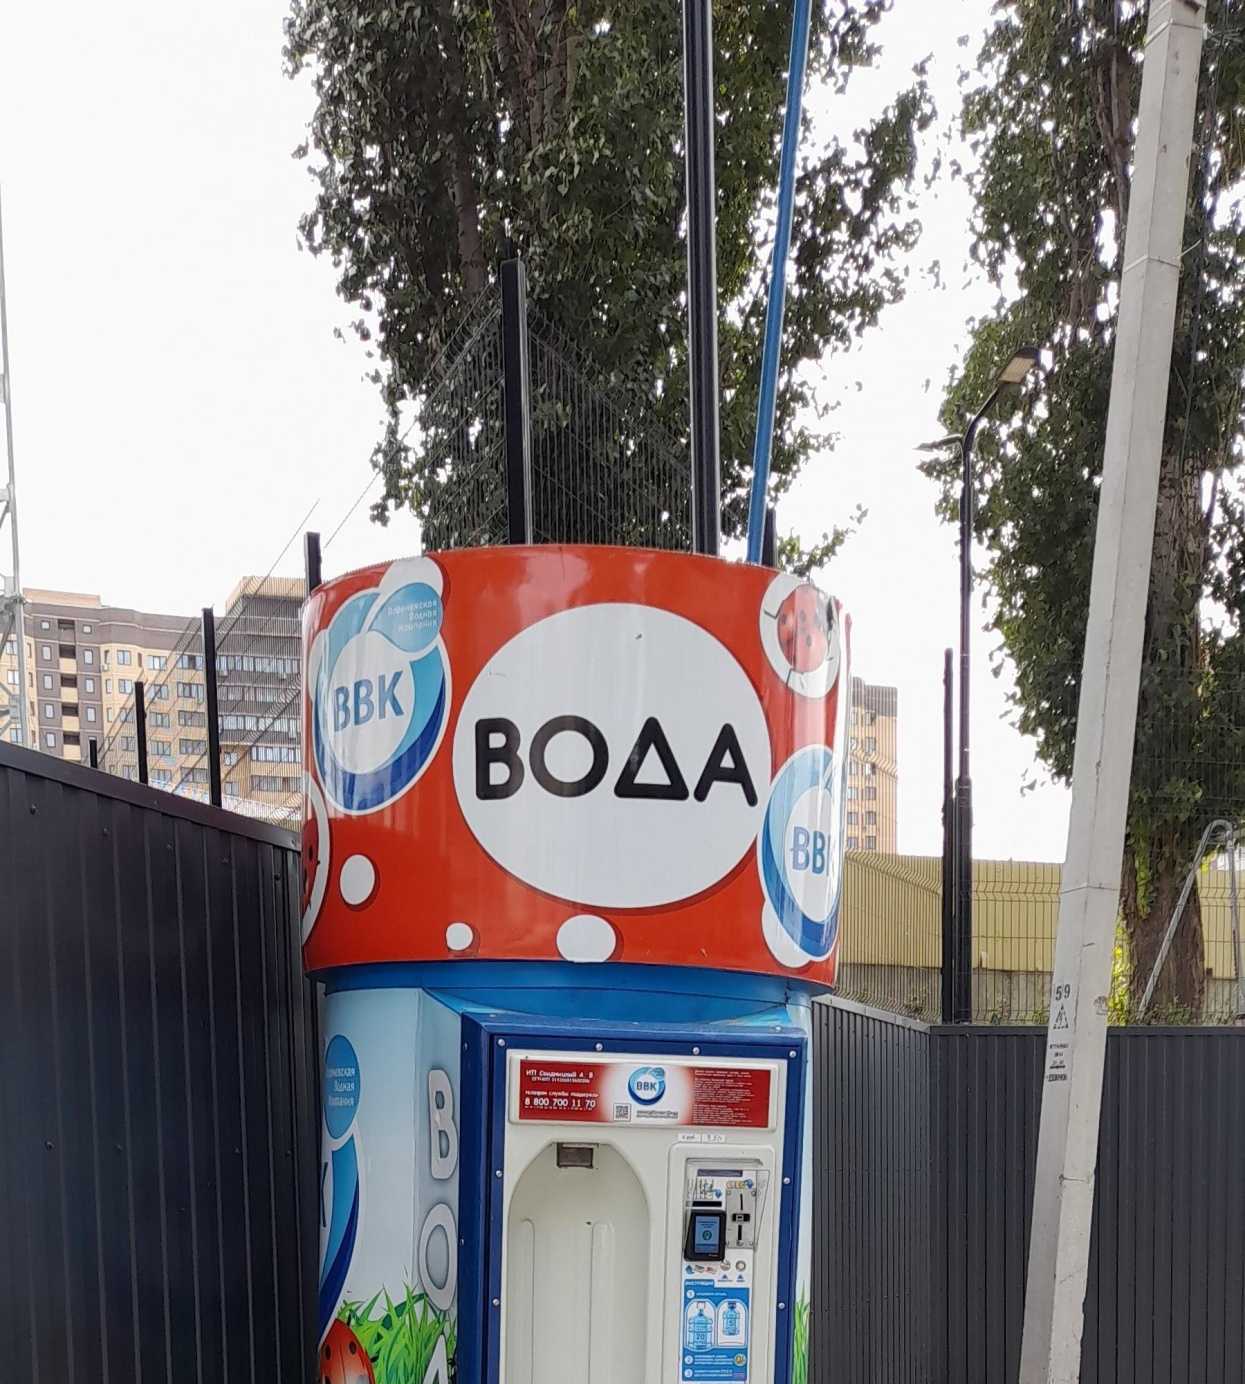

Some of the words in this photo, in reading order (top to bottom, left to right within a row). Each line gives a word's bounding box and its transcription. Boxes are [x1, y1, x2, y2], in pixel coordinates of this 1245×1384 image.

[334, 670, 404, 732] ВВК
[475, 714, 758, 807] ВОДА
[1055, 983, 1071, 1001] 59
[636, 1081, 657, 1092] ВВК
[524, 1096, 531, 1106] 8
[533, 1097, 550, 1107] 800
[552, 1098, 569, 1107] 700
[572, 1098, 582, 1108] 11
[585, 1099, 597, 1109] 70
